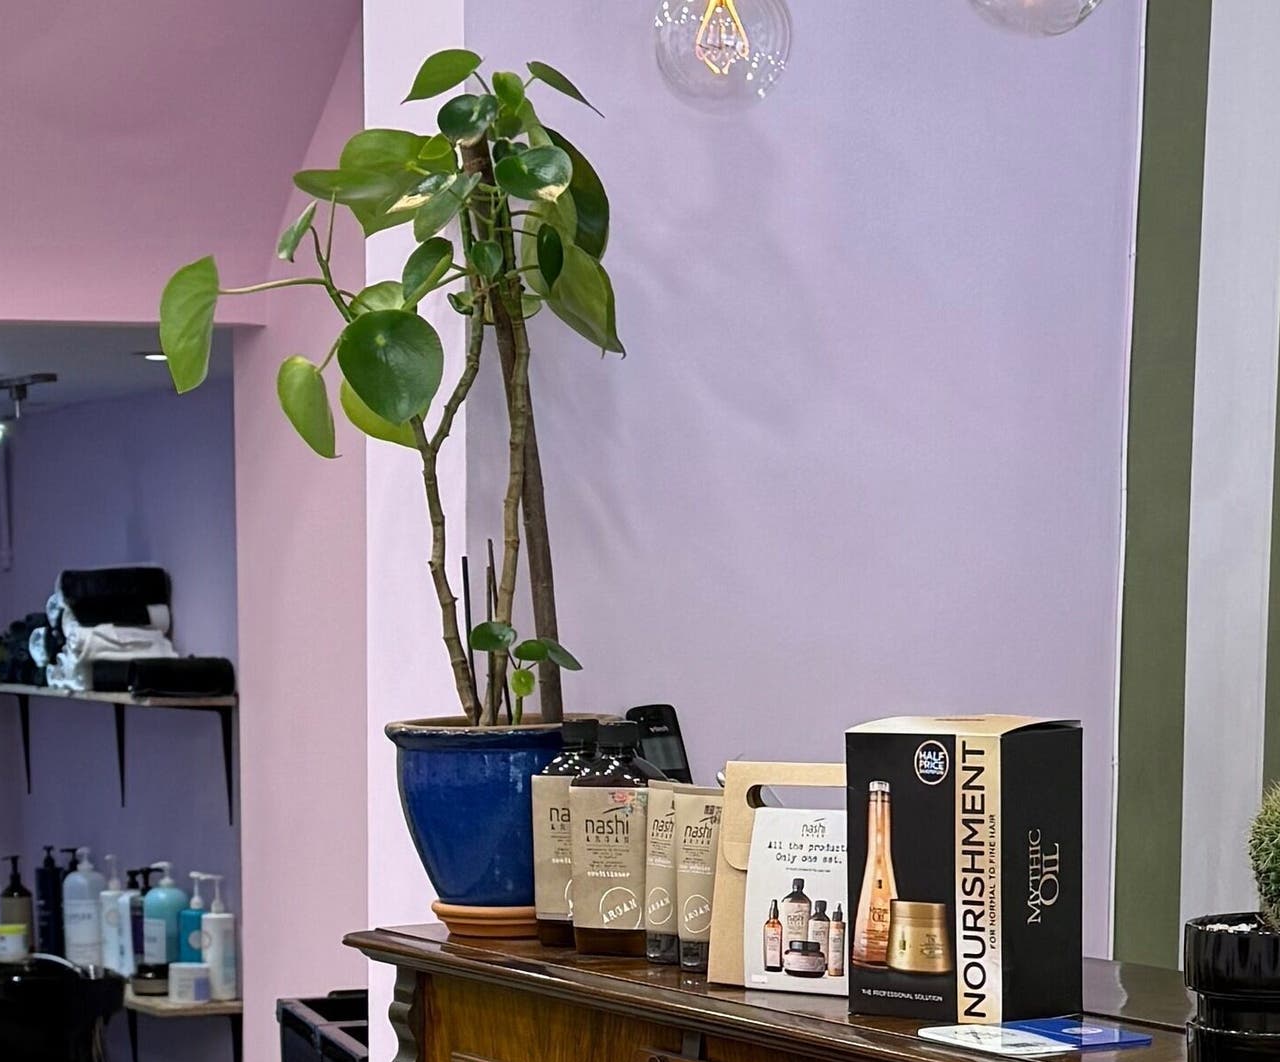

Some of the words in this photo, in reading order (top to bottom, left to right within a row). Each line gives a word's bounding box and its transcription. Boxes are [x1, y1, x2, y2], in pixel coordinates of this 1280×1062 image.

[919, 751, 946, 761] HALF
[919, 760, 945, 771] PRICE
[585, 814, 629, 835] nashi
[988, 814, 997, 839] HAIR
[768, 841, 783, 850] All
[789, 842, 803, 850] the
[988, 841, 997, 865] FINE
[775, 852, 798, 864] Only
[801, 855, 818, 863] one
[961, 740, 987, 1018] NOURISHMENT
[988, 866, 997, 880] TO
[1027, 828, 1042, 925] MYTHIC
[1039, 842, 1060, 906] OIL
[601, 898, 638, 923] ARGAN
[988, 884, 997, 927] NORMAL
[989, 929, 997, 950] FOR
